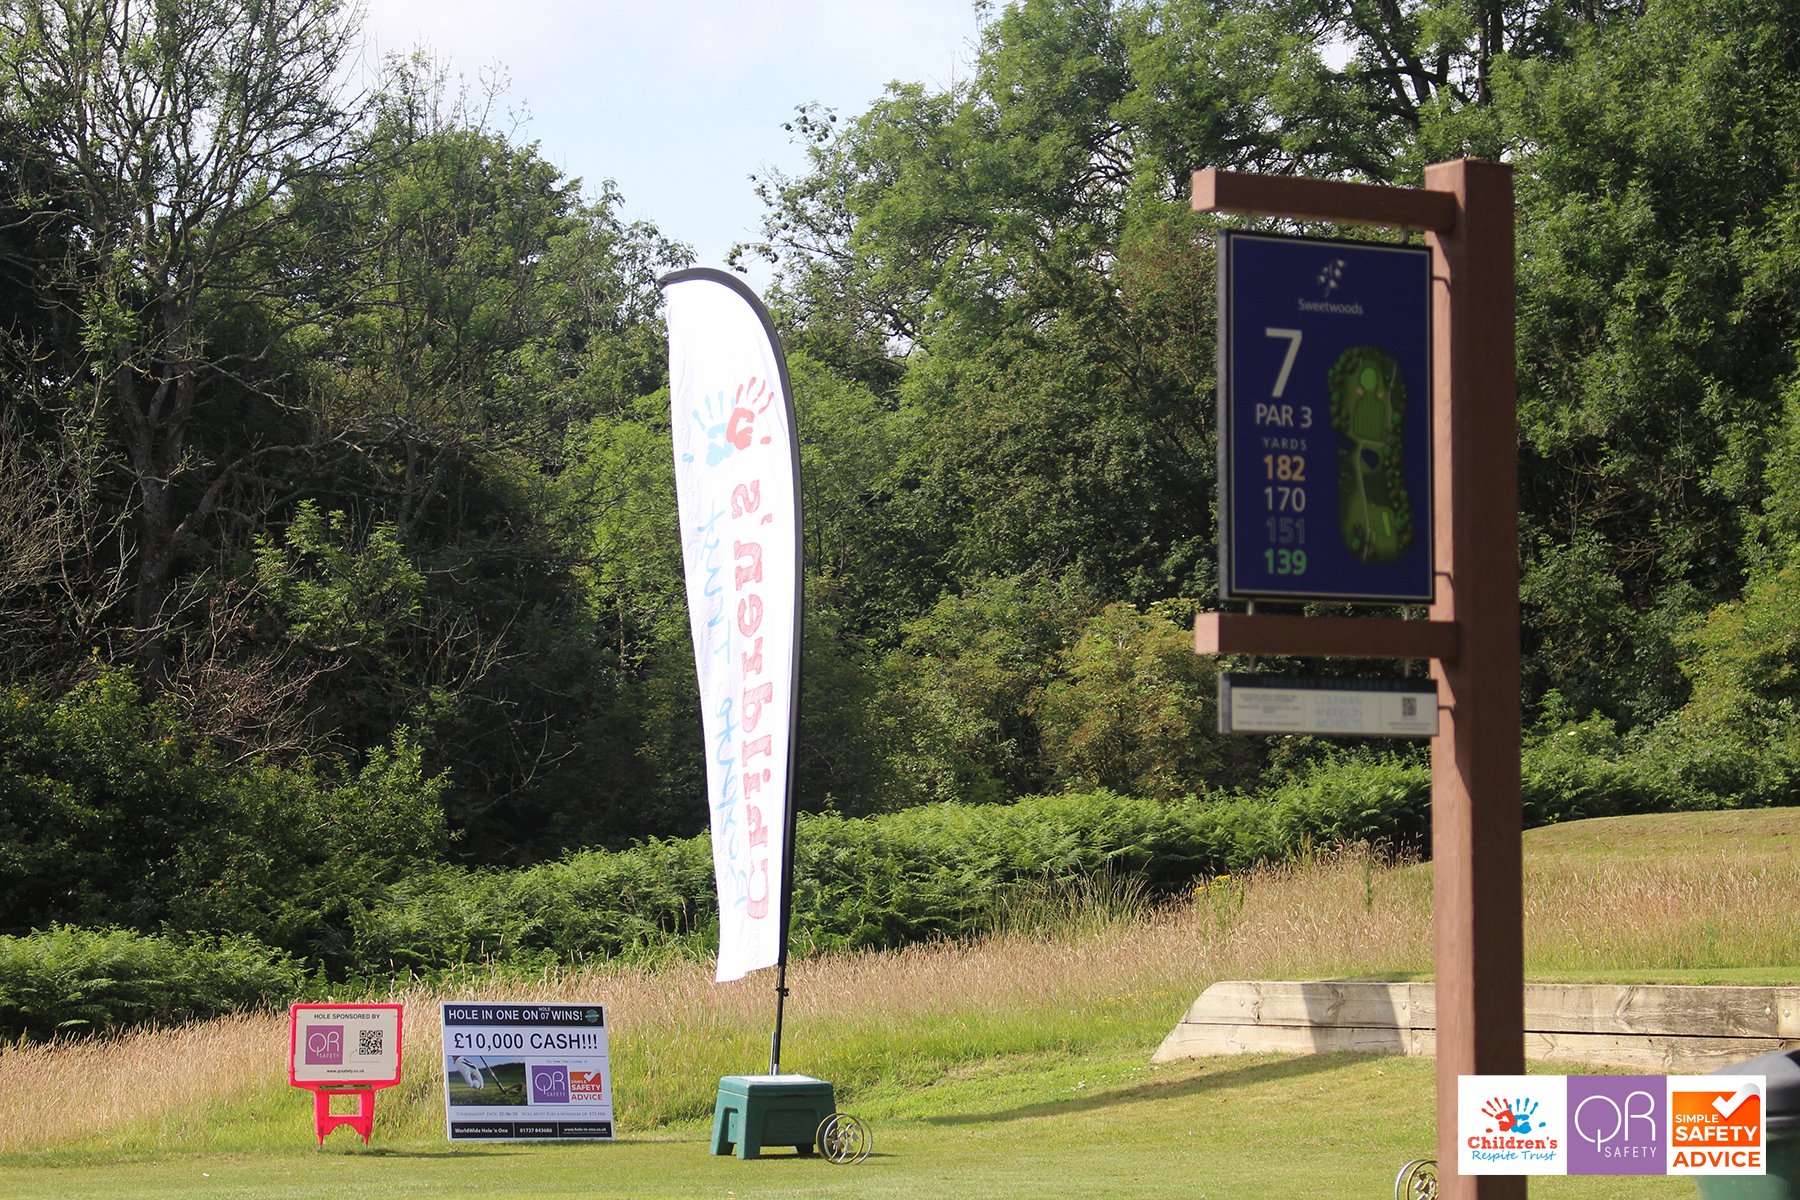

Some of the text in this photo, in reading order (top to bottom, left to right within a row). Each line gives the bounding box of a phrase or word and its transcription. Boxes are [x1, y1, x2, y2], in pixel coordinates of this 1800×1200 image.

[1298, 298, 1364, 316] Sweetwoods
[1265, 327, 1303, 398] 7
[1255, 402, 1313, 429] PAR 3
[1263, 436, 1308, 451] YARDS
[1264, 454, 1307, 482] 182
[1264, 486, 1307, 512] 170
[1266, 517, 1306, 544] 151
[1264, 548, 1308, 576] 139
[448, 1009, 539, 1020] HOLE IN ONE ON
[540, 1012, 550, 1020] 07
[551, 1010, 583, 1021] WINS!
[308, 1031, 340, 1057] QR
[454, 1032, 599, 1052] £10,000 CASH!!!
[534, 1070, 566, 1095] QR
[571, 1093, 603, 1101] ADVICE
